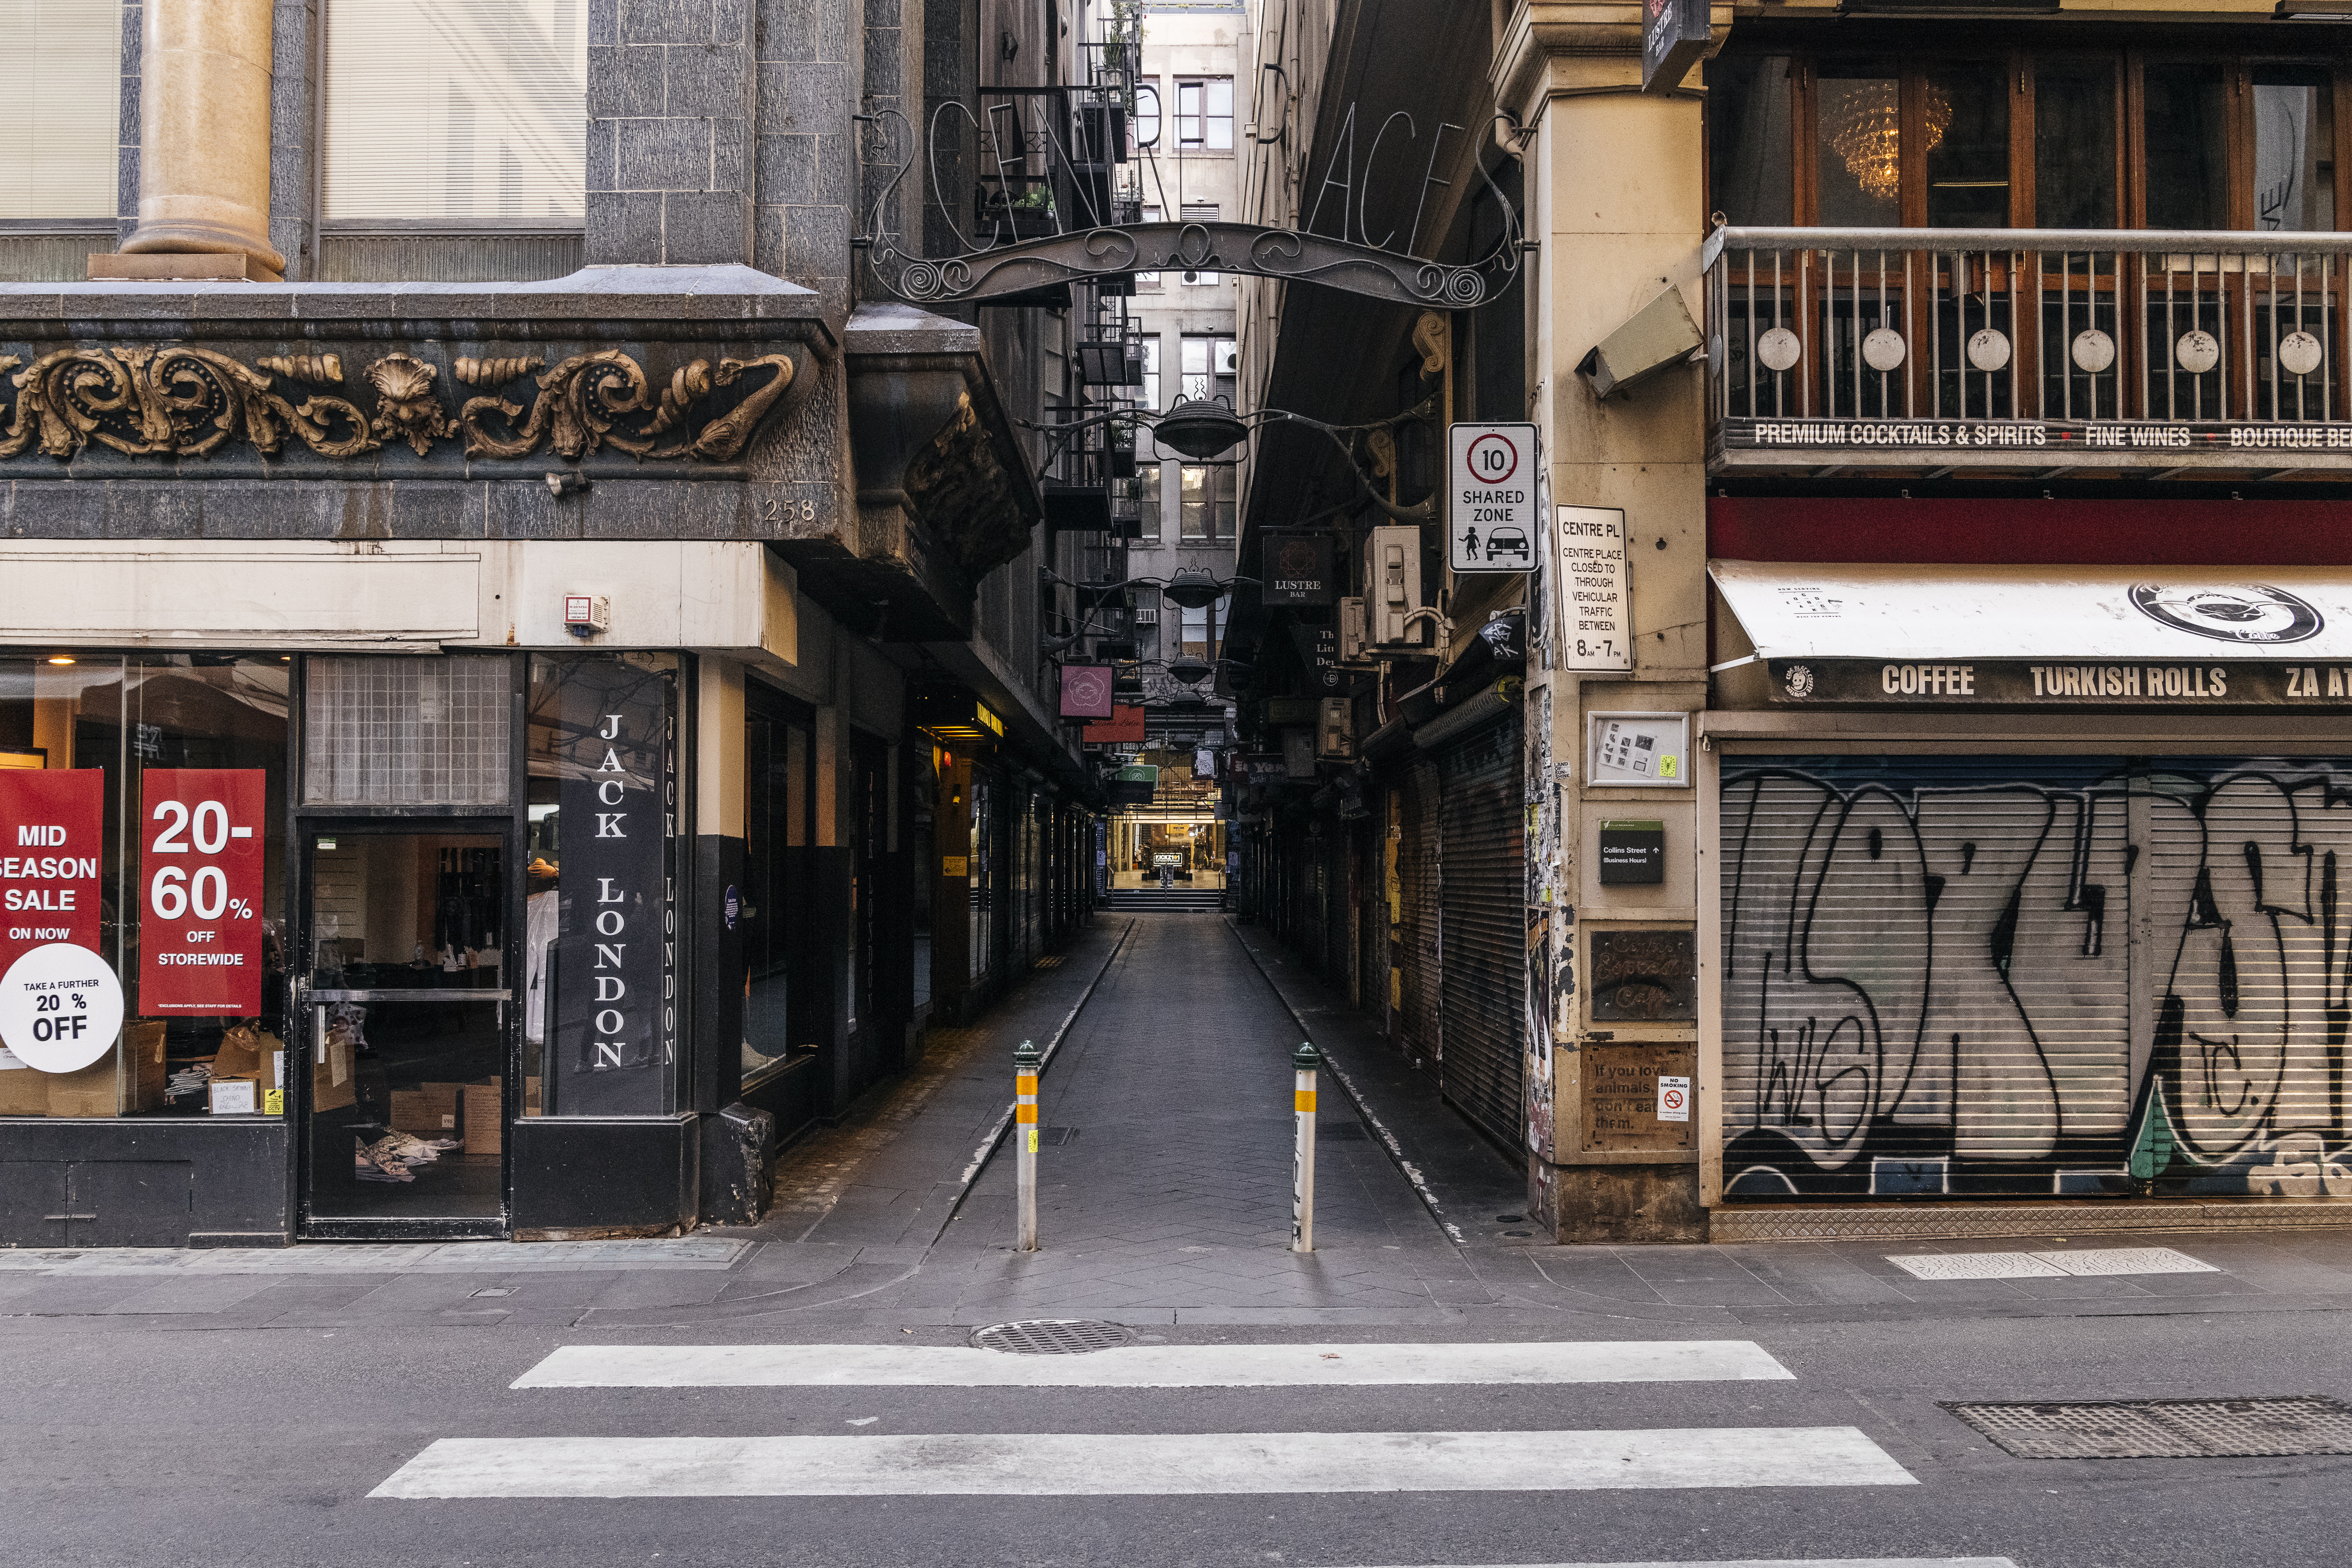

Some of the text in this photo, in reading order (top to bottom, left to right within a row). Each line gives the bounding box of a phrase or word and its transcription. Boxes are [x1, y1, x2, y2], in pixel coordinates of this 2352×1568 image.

[1648, 1, 1672, 53] LUSTRE
[1656, 36, 1665, 57] BAR
[1756, 423, 2352, 449] PREMIUM COCKTAILS & SPIRITS FINE WINES BOUTIQUE BE
[1482, 449, 1505, 471] 10
[1463, 490, 1525, 504] SHARED
[765, 499, 815, 522] 258
[1474, 509, 1514, 521] ZONE
[1563, 521, 1620, 538] CENTRE PL
[1563, 547, 1622, 560] CENTRE PLACE
[1571, 562, 1615, 574] CLOSED TO
[1275, 581, 1321, 590] LUSTRE
[1575, 577, 1613, 588] THROUGH
[1572, 591, 1618, 603] VEHICULAR
[1579, 606, 1613, 617] TRAFFIC
[1579, 621, 1615, 631] BETWEEN
[1786, 667, 1794, 680] CODE
[1794, 665, 1810, 674] BLACK
[1882, 665, 1975, 695] COFFEE
[2030, 666, 2227, 697] TURKISH ROLLS
[2286, 667, 2320, 697] ZA
[1785, 684, 1807, 697] ROASTERS
[595, 714, 627, 838] JACK
[666, 716, 674, 838] JACK
[18, 825, 67, 847] MID
[0, 857, 96, 879] EASON
[5, 888, 76, 911] SALE
[151, 865, 253, 921] 60%
[9, 927, 70, 940] ON NOW
[186, 931, 215, 942] OFF
[158, 953, 244, 965] STOREWIDE
[593, 878, 626, 1067] LONDON
[664, 877, 674, 1065] LONDON
[24, 982, 47, 991] TAKE
[58, 979, 99, 989] FURTHER
[36, 993, 86, 1012] 20 %
[32, 1015, 87, 1042] OFF
[1595, 1064, 1669, 1079] If you love
[1596, 1081, 1655, 1095] animals,
[1596, 1116, 1635, 1129] them.
